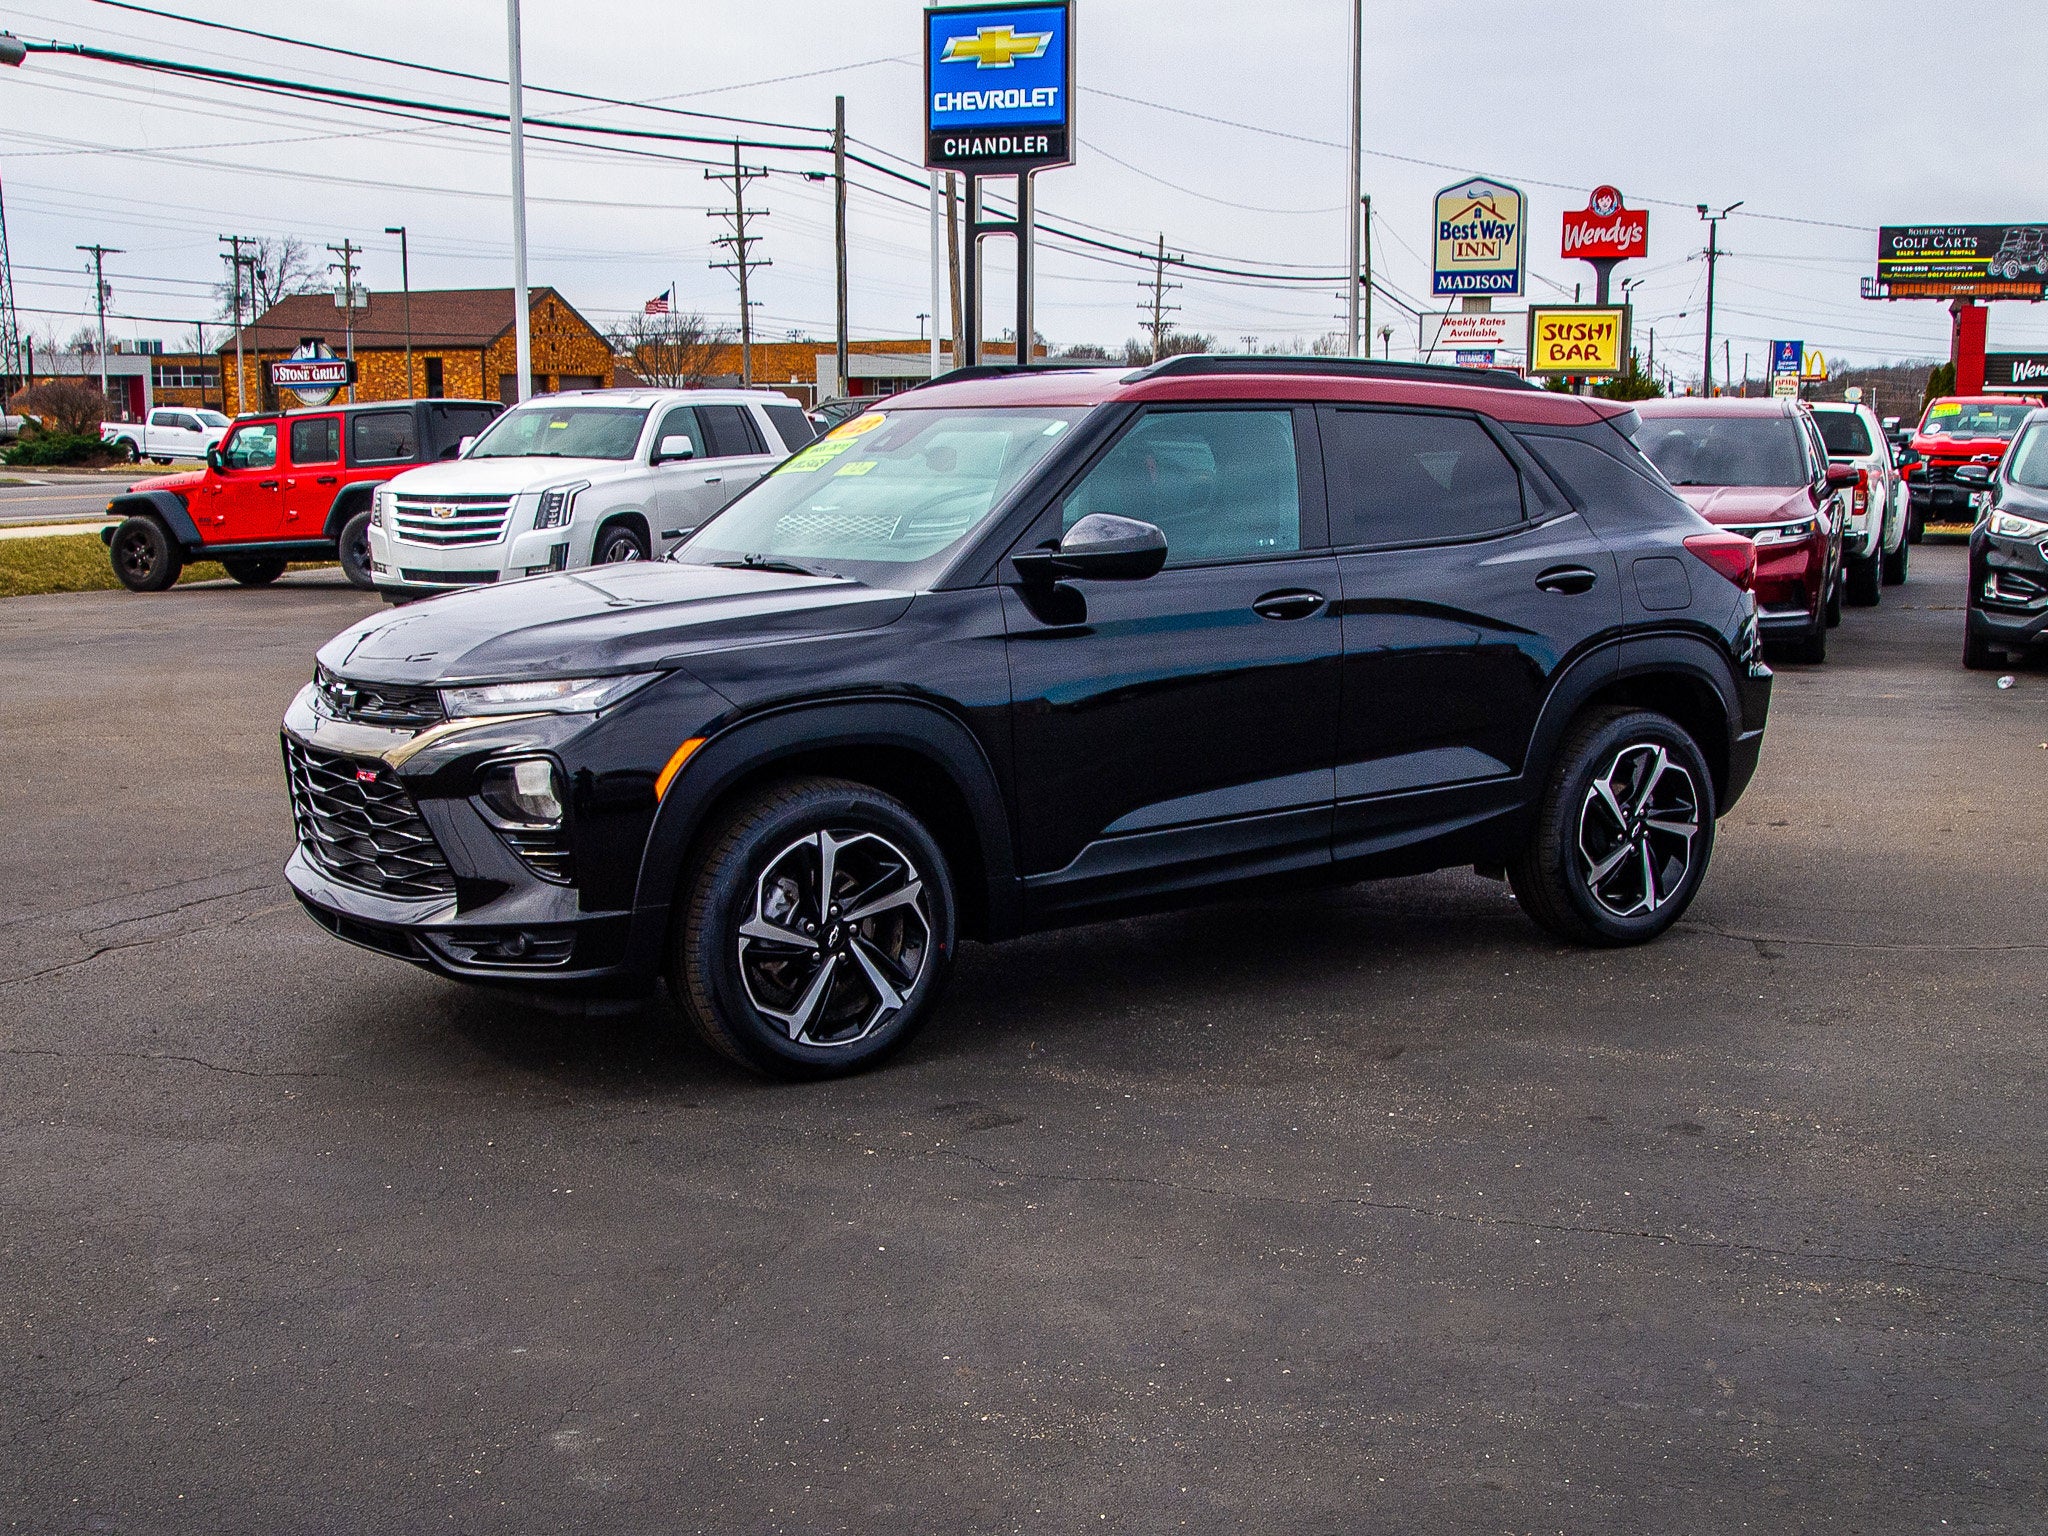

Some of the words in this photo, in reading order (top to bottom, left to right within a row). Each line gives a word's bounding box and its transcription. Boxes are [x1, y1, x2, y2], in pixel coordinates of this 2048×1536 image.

[934, 87, 1058, 112] CHEVROLET
[944, 136, 1048, 156] CHANDLER
[1440, 220, 1478, 240] Best
[1479, 219, 1515, 246] Way
[1564, 217, 1643, 251] Wendy's
[1456, 241, 1497, 257] INN
[1892, 236, 1929, 249] GOLF
[1933, 235, 1978, 248] CARTS
[1438, 275, 1513, 290] MADISON
[1443, 317, 1477, 328] Weekly
[1480, 317, 1506, 326] Rates
[1450, 328, 1497, 337] Available
[1543, 323, 1612, 341] SUSHI
[1550, 344, 1602, 361] BAR
[279, 366, 310, 381] STONE
[312, 366, 341, 380] GRILL
[2012, 359, 2048, 383] Wen
